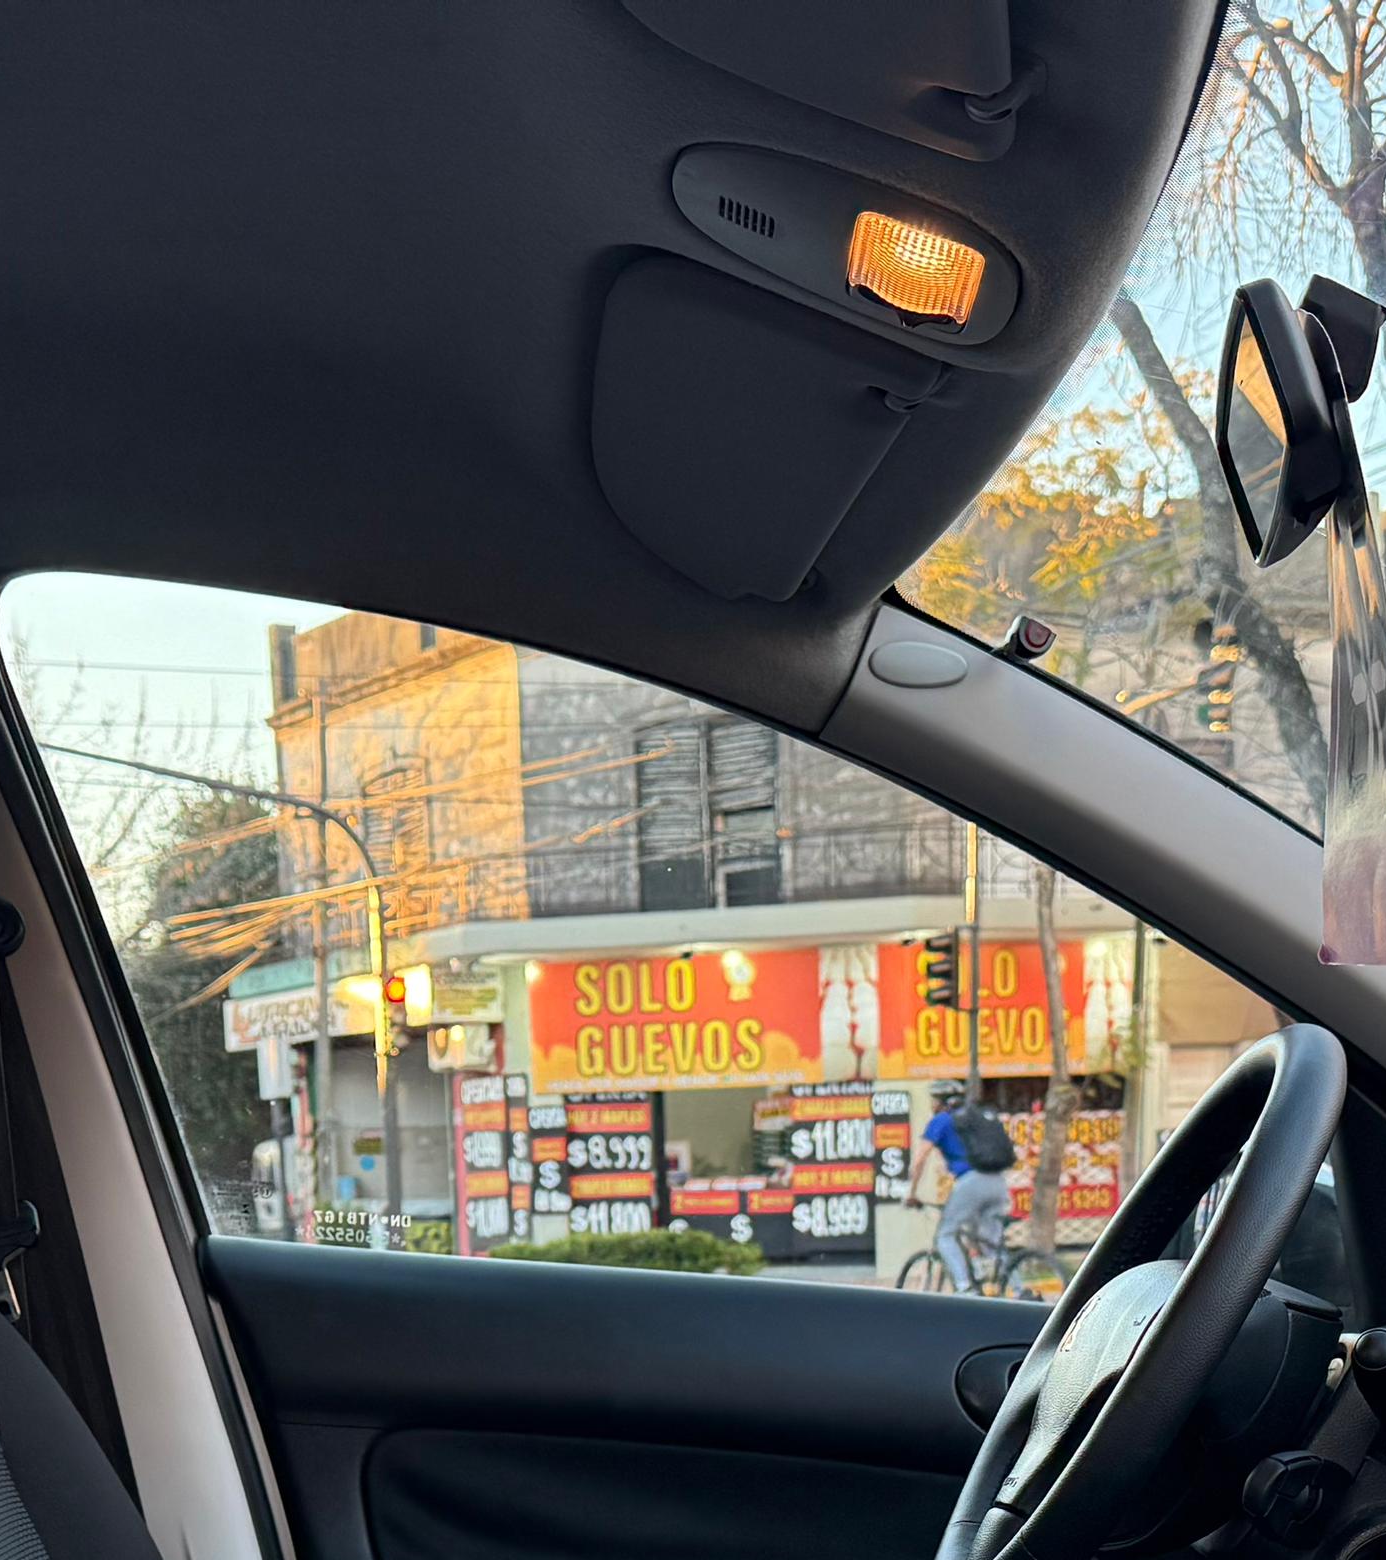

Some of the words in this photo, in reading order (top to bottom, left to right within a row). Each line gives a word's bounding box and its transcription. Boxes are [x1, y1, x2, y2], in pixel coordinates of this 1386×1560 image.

[574, 957, 696, 1016] SOLO
[576, 1016, 764, 1077] GUEVOS
[916, 1005, 1069, 1057] GUEVO
